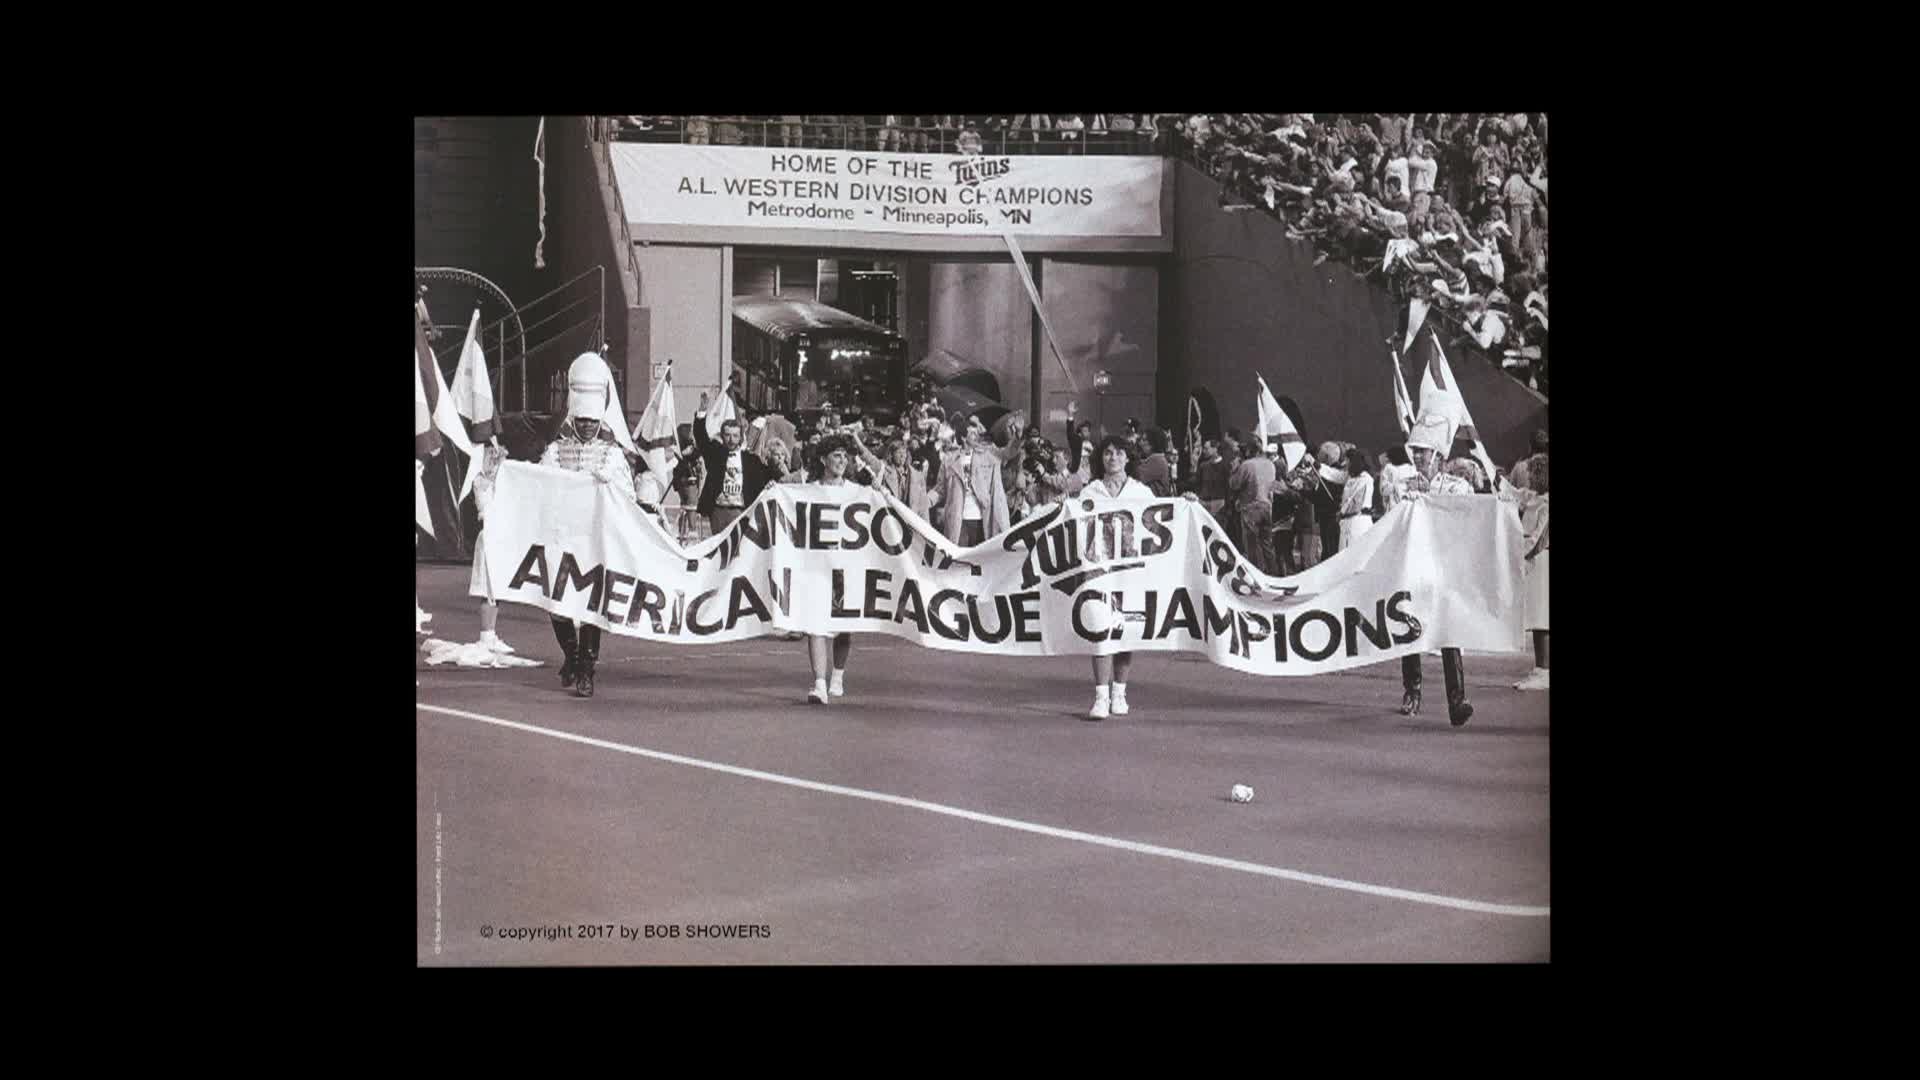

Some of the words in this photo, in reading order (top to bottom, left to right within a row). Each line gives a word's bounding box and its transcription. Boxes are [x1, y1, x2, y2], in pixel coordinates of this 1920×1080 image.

[772, 154, 837, 174] HOME
[848, 156, 878, 176] OF
[888, 160, 932, 180] THE
[949, 157, 1010, 187] Twins
[678, 177, 717, 195] A.L.
[724, 178, 839, 200] WESTERN
[850, 183, 947, 205] DIVISION
[959, 187, 1093, 206] CHAMPIONS
[748, 201, 855, 220] Metrodome
[882, 206, 989, 228] Minneapolis,
[686, 498, 982, 576] INNESO
[1002, 498, 1174, 594] Twins
[508, 543, 792, 636] AMERICAN
[830, 567, 1042, 644] LEAGUE
[1071, 587, 1424, 663] CHAMPIONS
